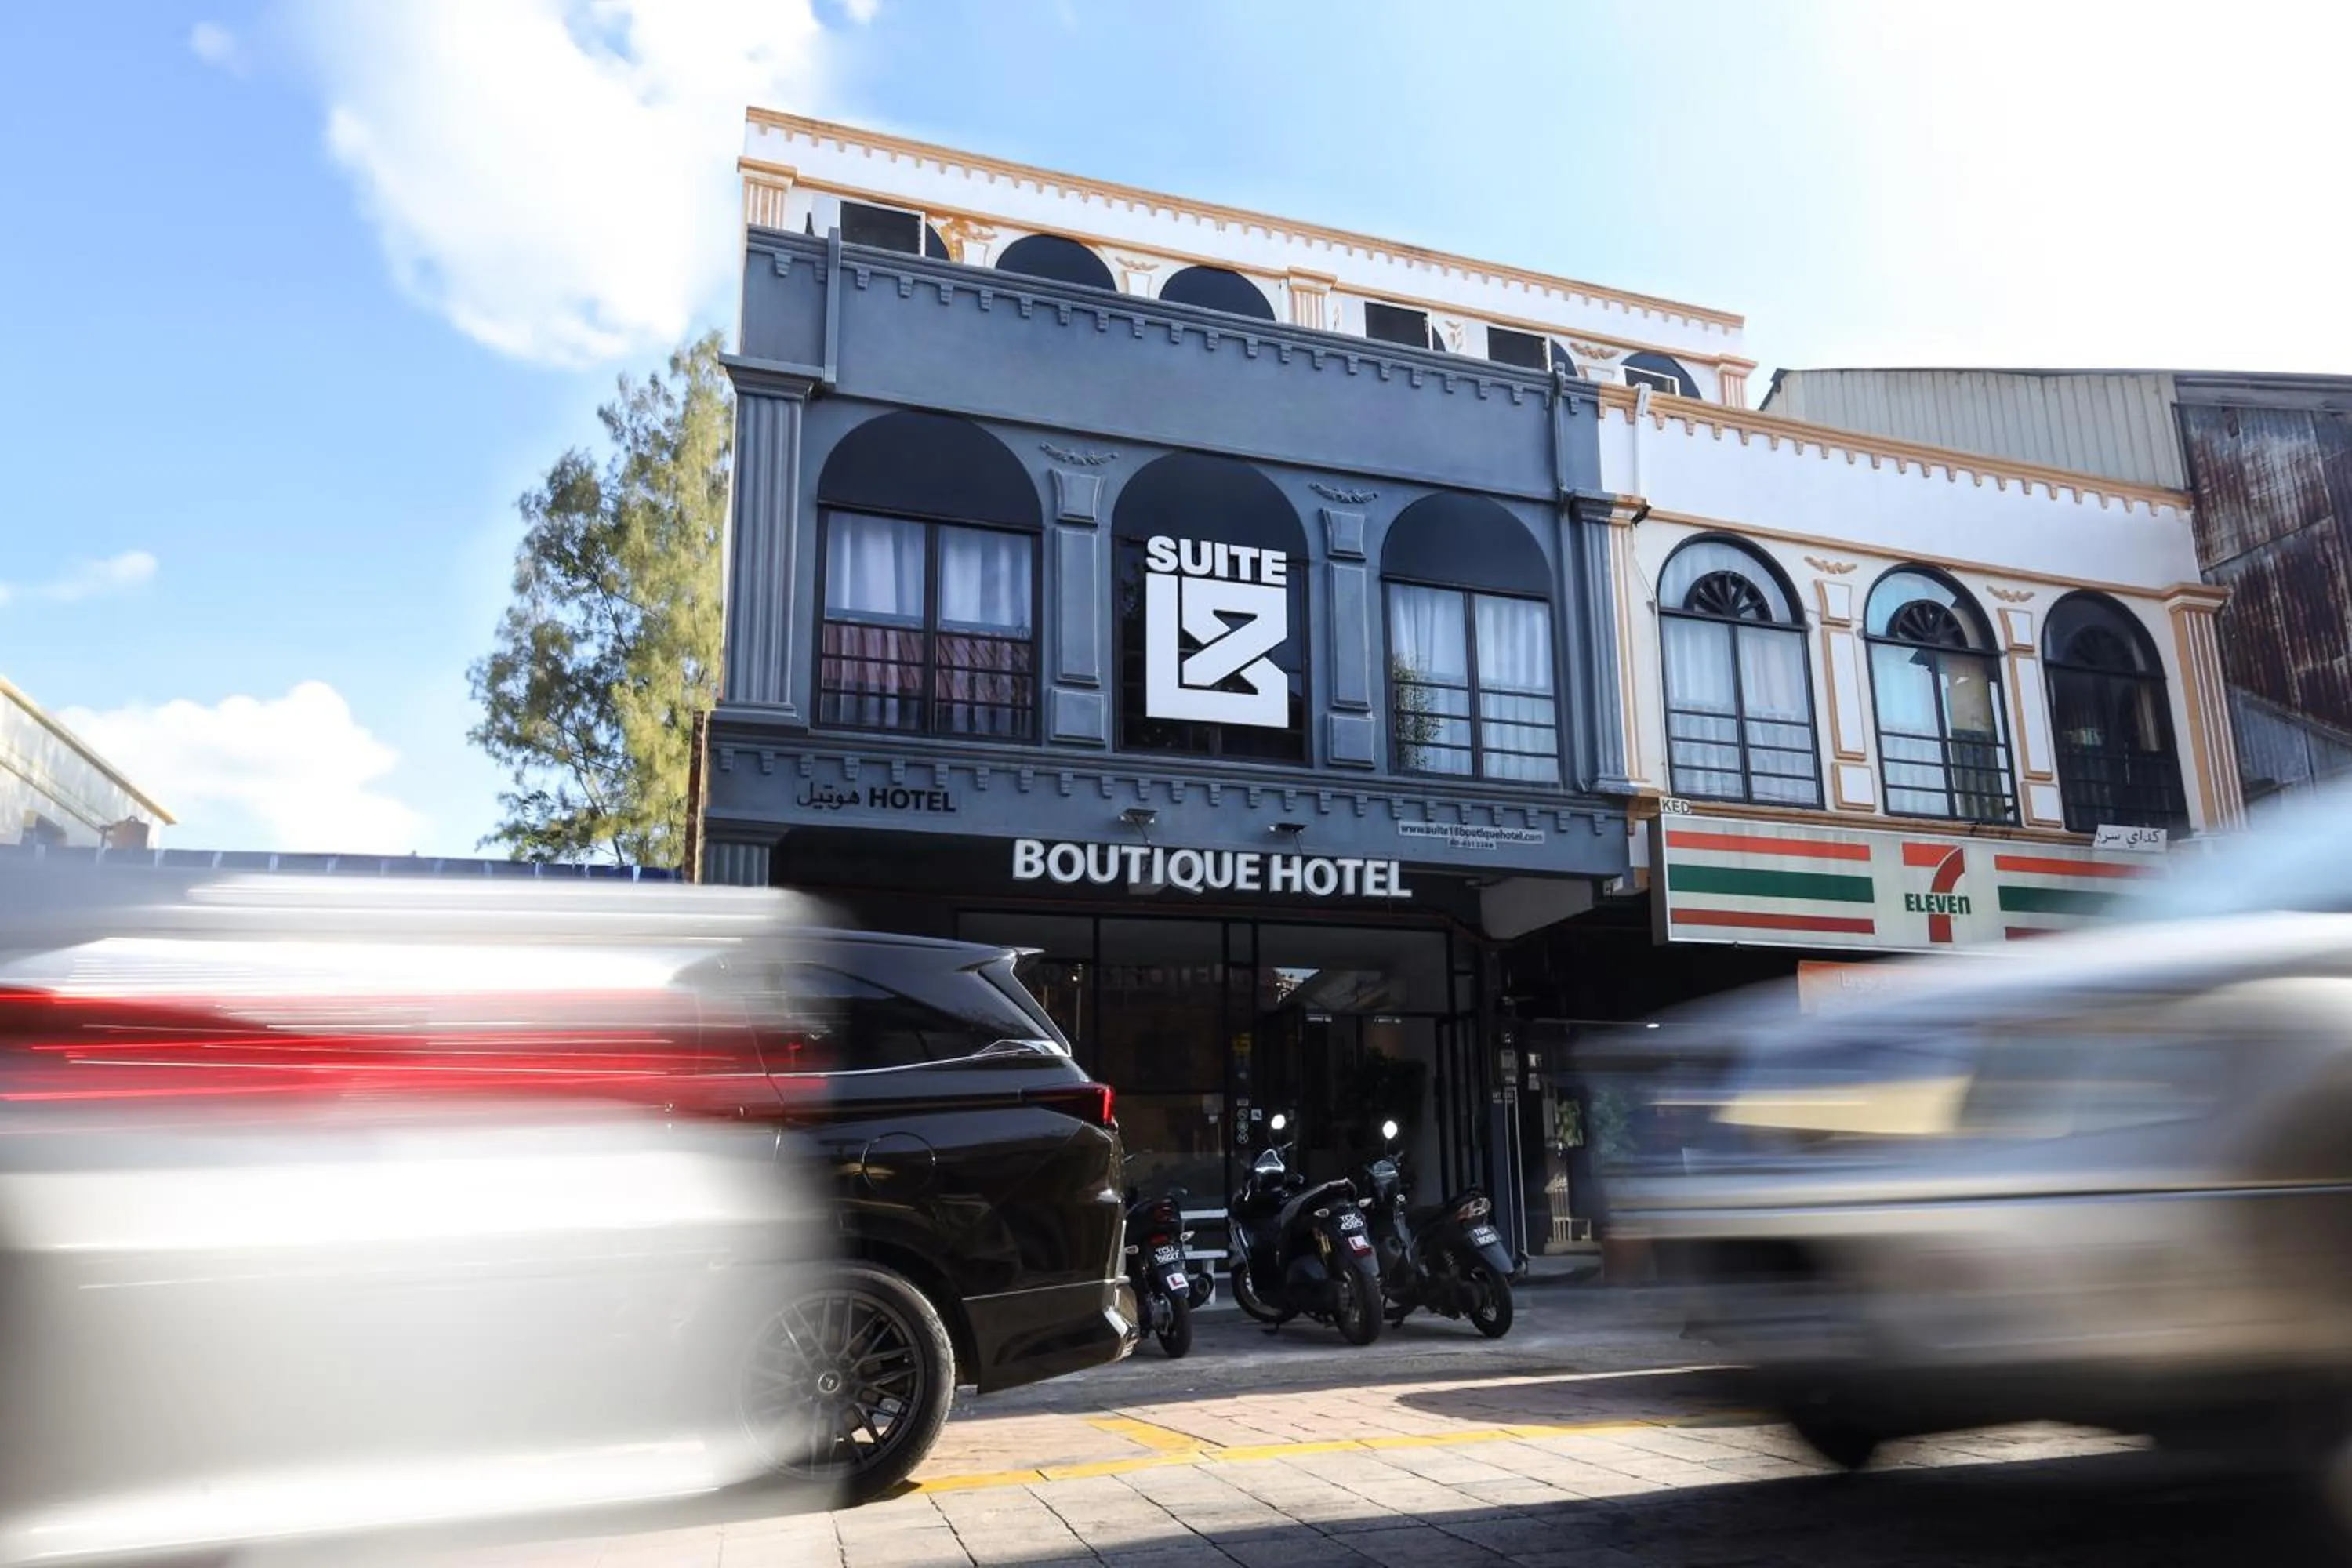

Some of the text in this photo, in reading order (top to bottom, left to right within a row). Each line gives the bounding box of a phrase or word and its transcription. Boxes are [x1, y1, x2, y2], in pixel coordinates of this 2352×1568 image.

[1145, 535, 1287, 585] SUITE
[797, 781, 860, 809] هوتيل
[869, 787, 957, 813] HOTEL
[1012, 839, 1413, 898] BOUTIQUE HOTEL
[1901, 841, 1965, 943] 7
